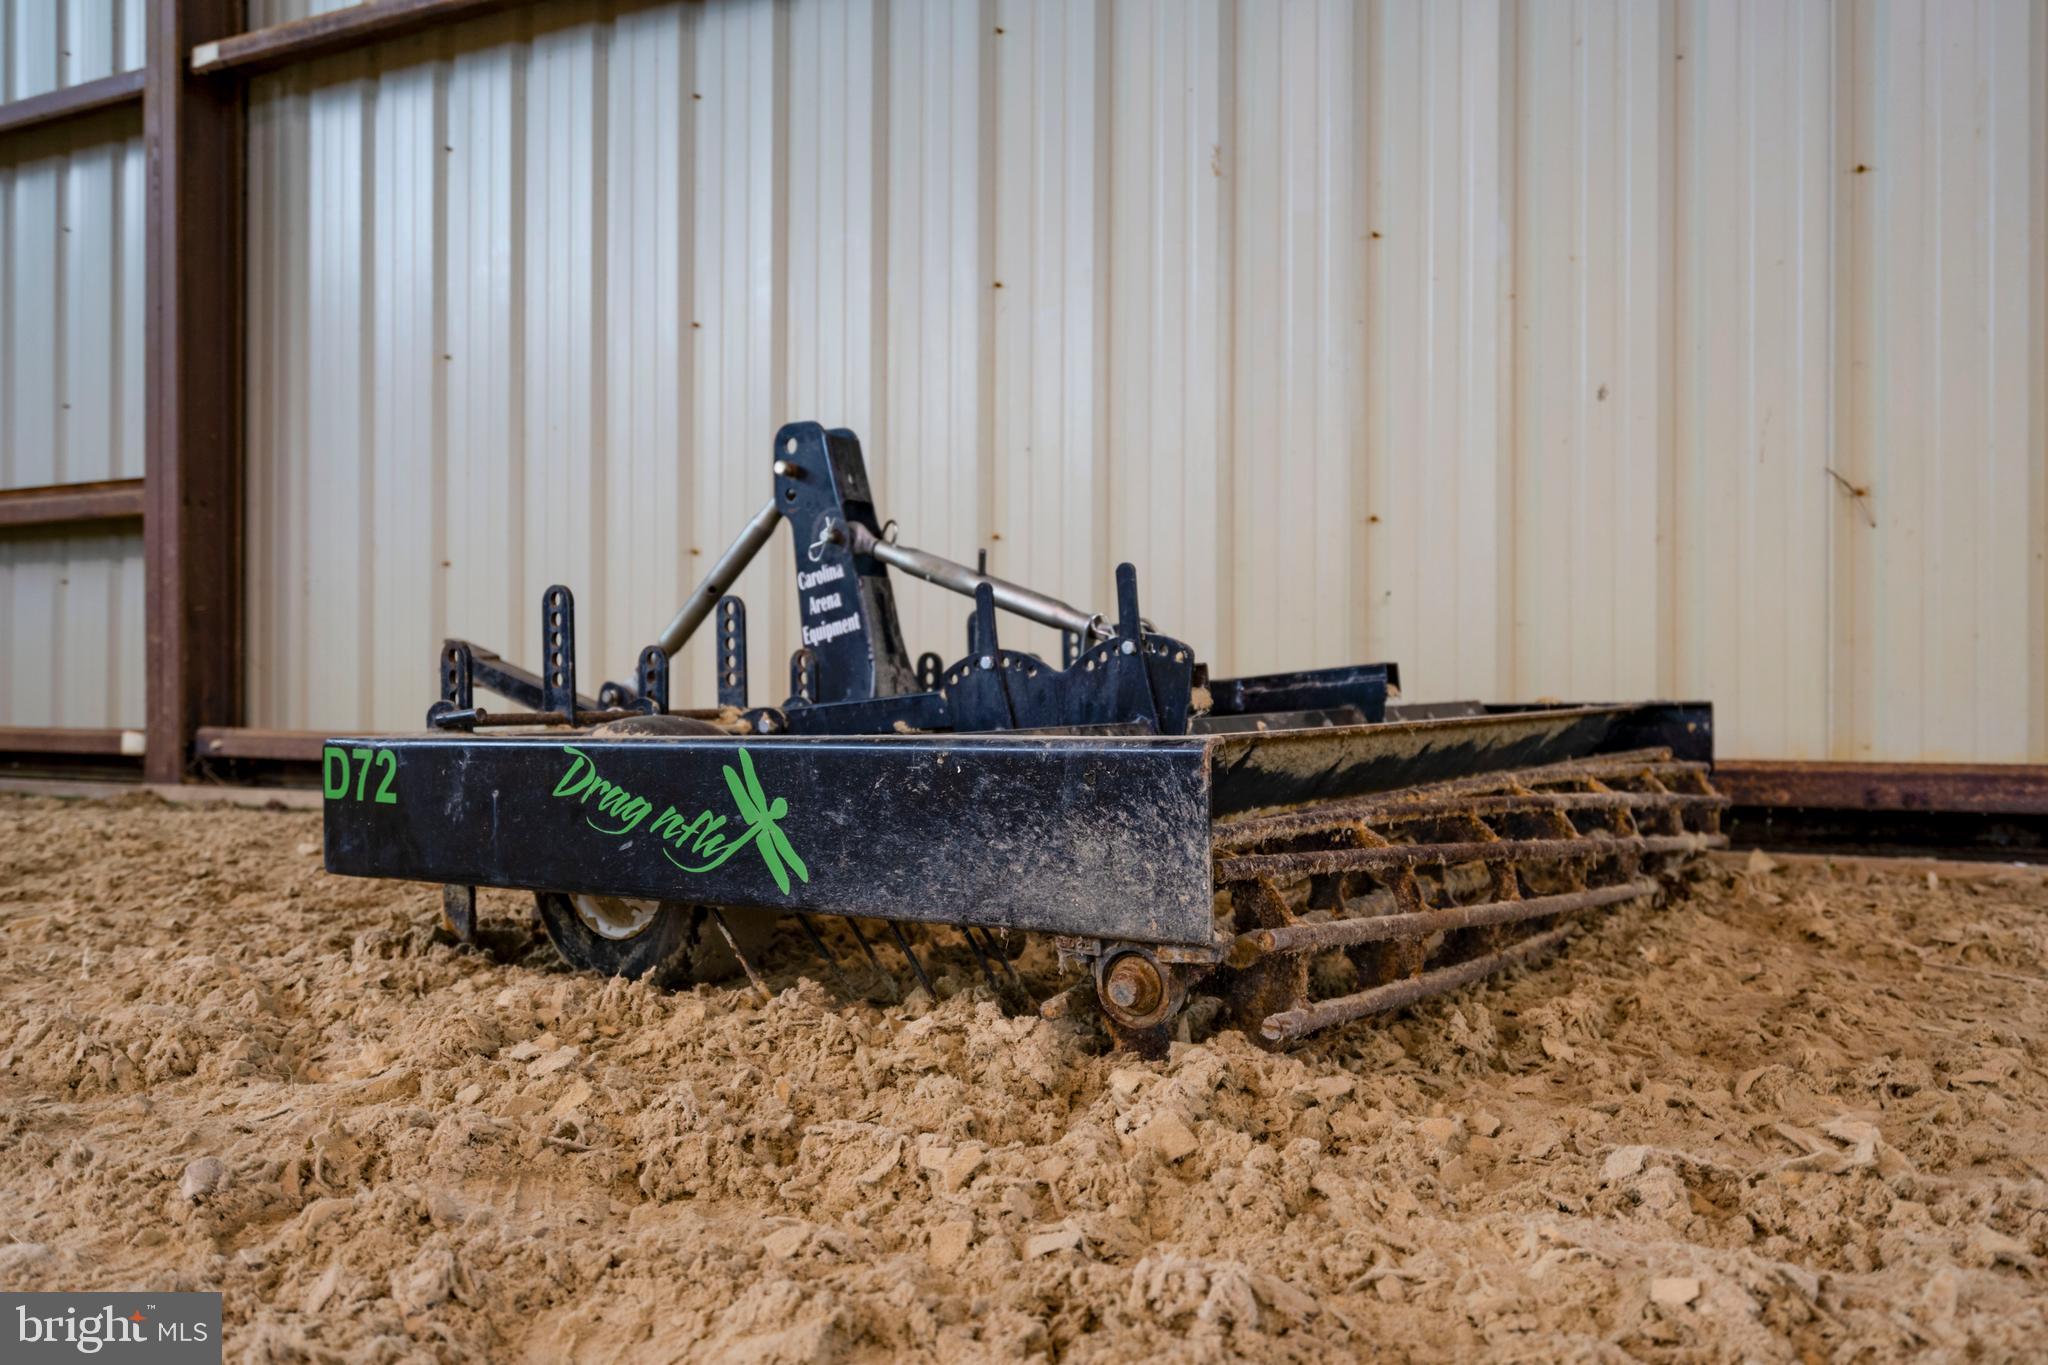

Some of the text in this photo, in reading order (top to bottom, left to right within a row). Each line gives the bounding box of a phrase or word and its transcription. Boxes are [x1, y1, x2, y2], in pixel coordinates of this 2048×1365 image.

[798, 563, 844, 590] Carolina
[809, 592, 842, 615] Arena
[802, 612, 861, 646] Equipment
[324, 747, 397, 804] D72
